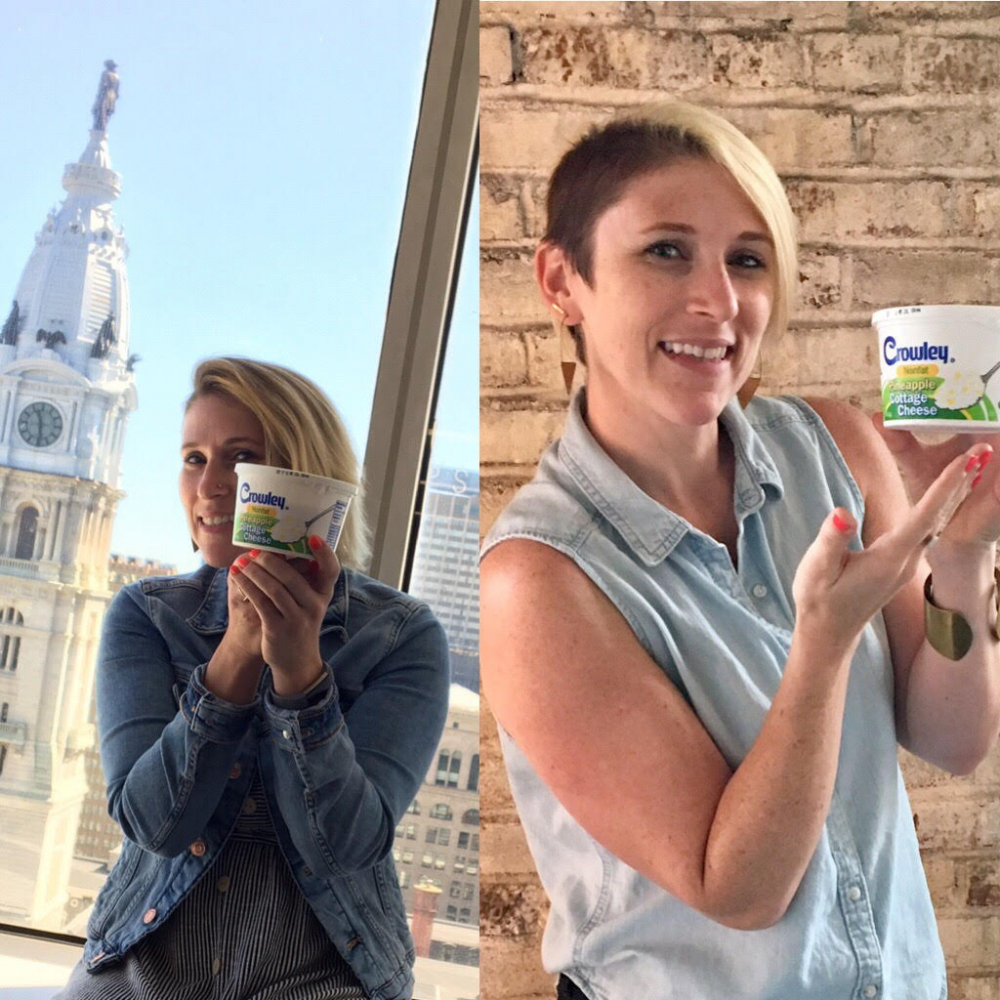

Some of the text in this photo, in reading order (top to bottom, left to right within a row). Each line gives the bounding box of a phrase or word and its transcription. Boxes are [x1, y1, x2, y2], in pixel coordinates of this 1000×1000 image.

[884, 336, 949, 365] Crowley
[889, 392, 928, 406] Cottage
[897, 404, 938, 416] Cheese
[240, 482, 286, 510] Crowley
